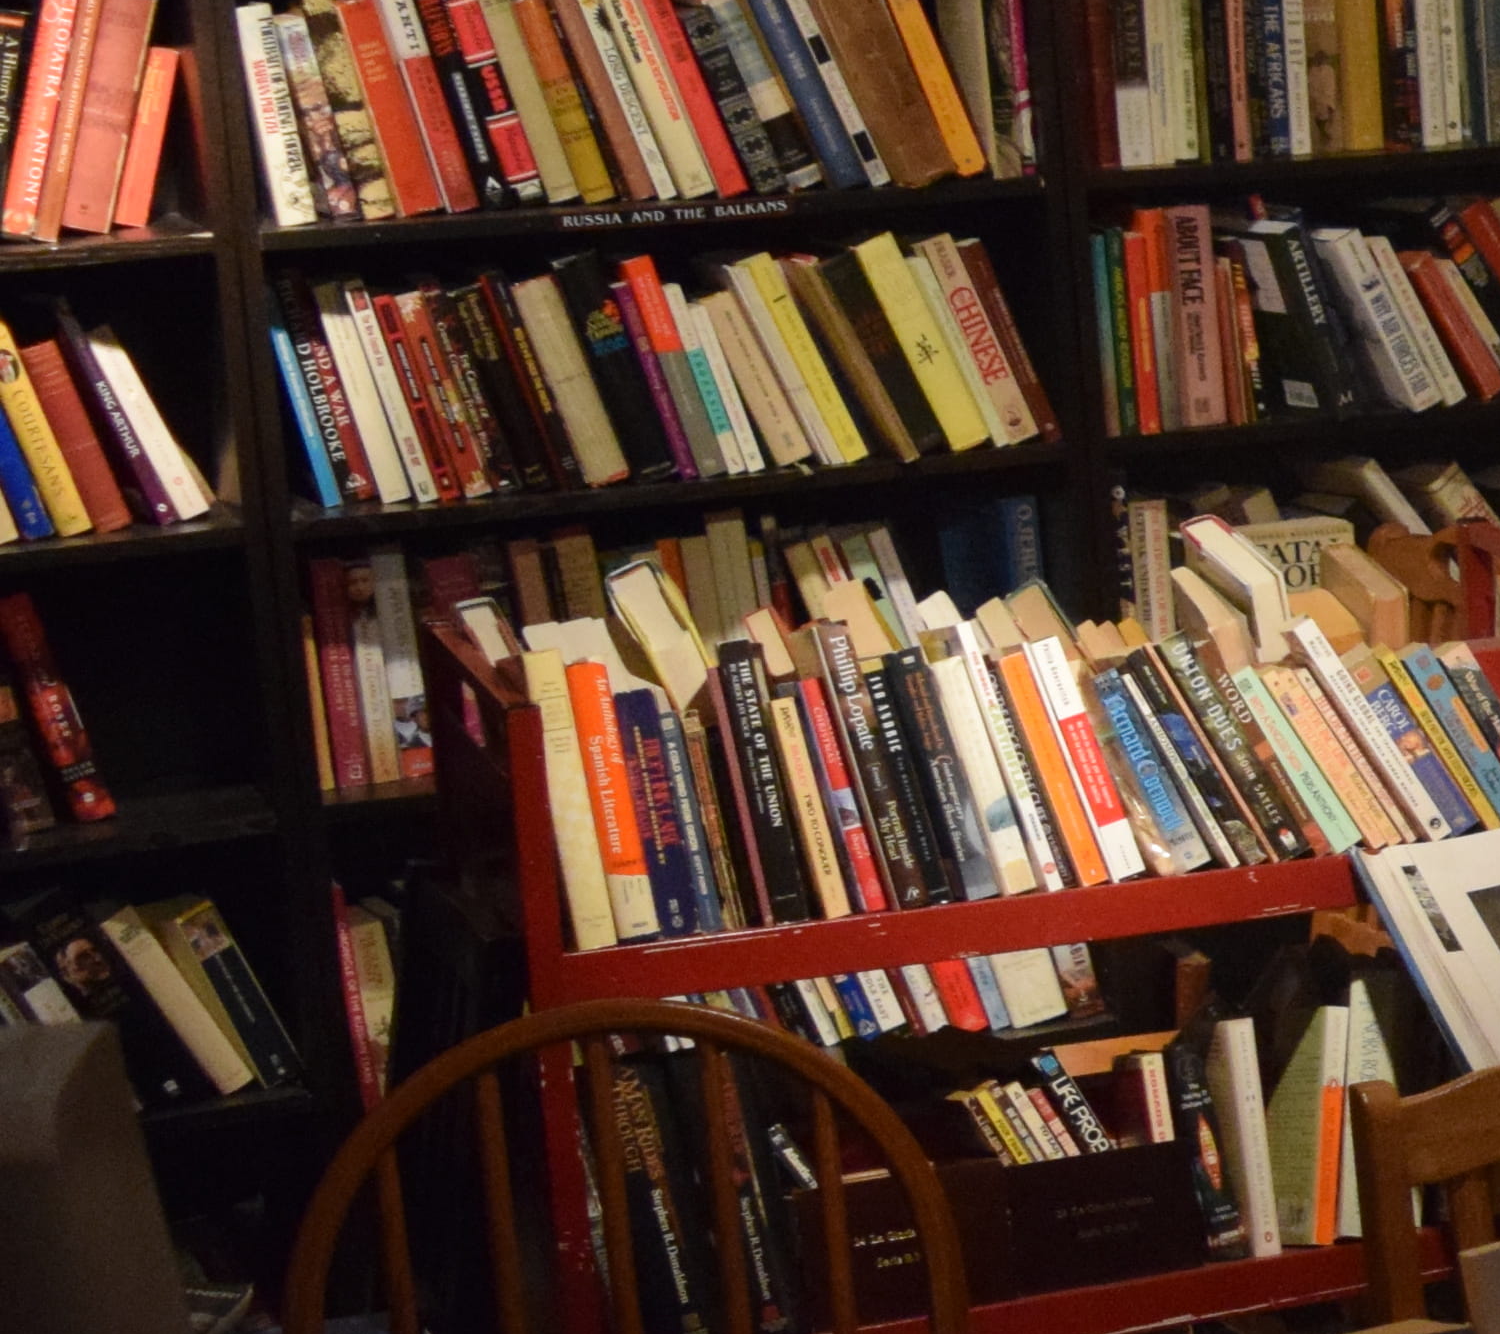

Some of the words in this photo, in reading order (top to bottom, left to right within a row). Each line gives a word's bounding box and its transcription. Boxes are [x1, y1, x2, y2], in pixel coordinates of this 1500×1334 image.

[22, 127, 50, 206] ANTONY
[561, 211, 623, 229] RUSSIA
[631, 208, 666, 223] AND
[673, 205, 706, 220] THE
[713, 199, 789, 218] BALKANS
[1174, 216, 1200, 265] ABOUT
[1181, 269, 1205, 306] FACE
[1285, 238, 1326, 326] ARTILLERY
[947, 285, 1010, 387] CHINESE
[1369, 292, 1395, 316] WHY
[1387, 336, 1422, 370] FORCES
[1405, 370, 1432, 396] FAIL
[12, 388, 67, 498] COURTESANS
[95, 379, 117, 411] KING
[109, 411, 141, 459] ARTHUR
[302, 357, 346, 462] HOLBROOKE
[737, 658, 756, 687] THE
[742, 687, 763, 729] STATE
[829, 634, 858, 694] Phillip
[846, 691, 877, 751] Lopate
[1214, 672, 1253, 724] WORD
[587, 735, 614, 786] Spanish
[752, 732, 768, 752] OF
[756, 754, 774, 781] THE
[1100, 694, 1147, 762] Bernard
[1135, 763, 1183, 831] Cornwell
[1168, 640, 1208, 699] UNION
[1206, 703, 1243, 753] DUES
[1253, 782, 1285, 824] SAYLES
[597, 787, 624, 855] Literature
[762, 783, 784, 828] UNION
[612, 1083, 642, 1173] THROUGH
[624, 1079, 648, 1121] MAN
[1051, 1075, 1080, 1113] LIFE
[1069, 1105, 1110, 1154] PROB
[635, 1126, 664, 1181] RIDES
[649, 1187, 676, 1234] Stephen
[664, 1244, 692, 1304] Donaldson
[736, 1196, 759, 1236] Stephen
[748, 1247, 774, 1300] Donaldson
